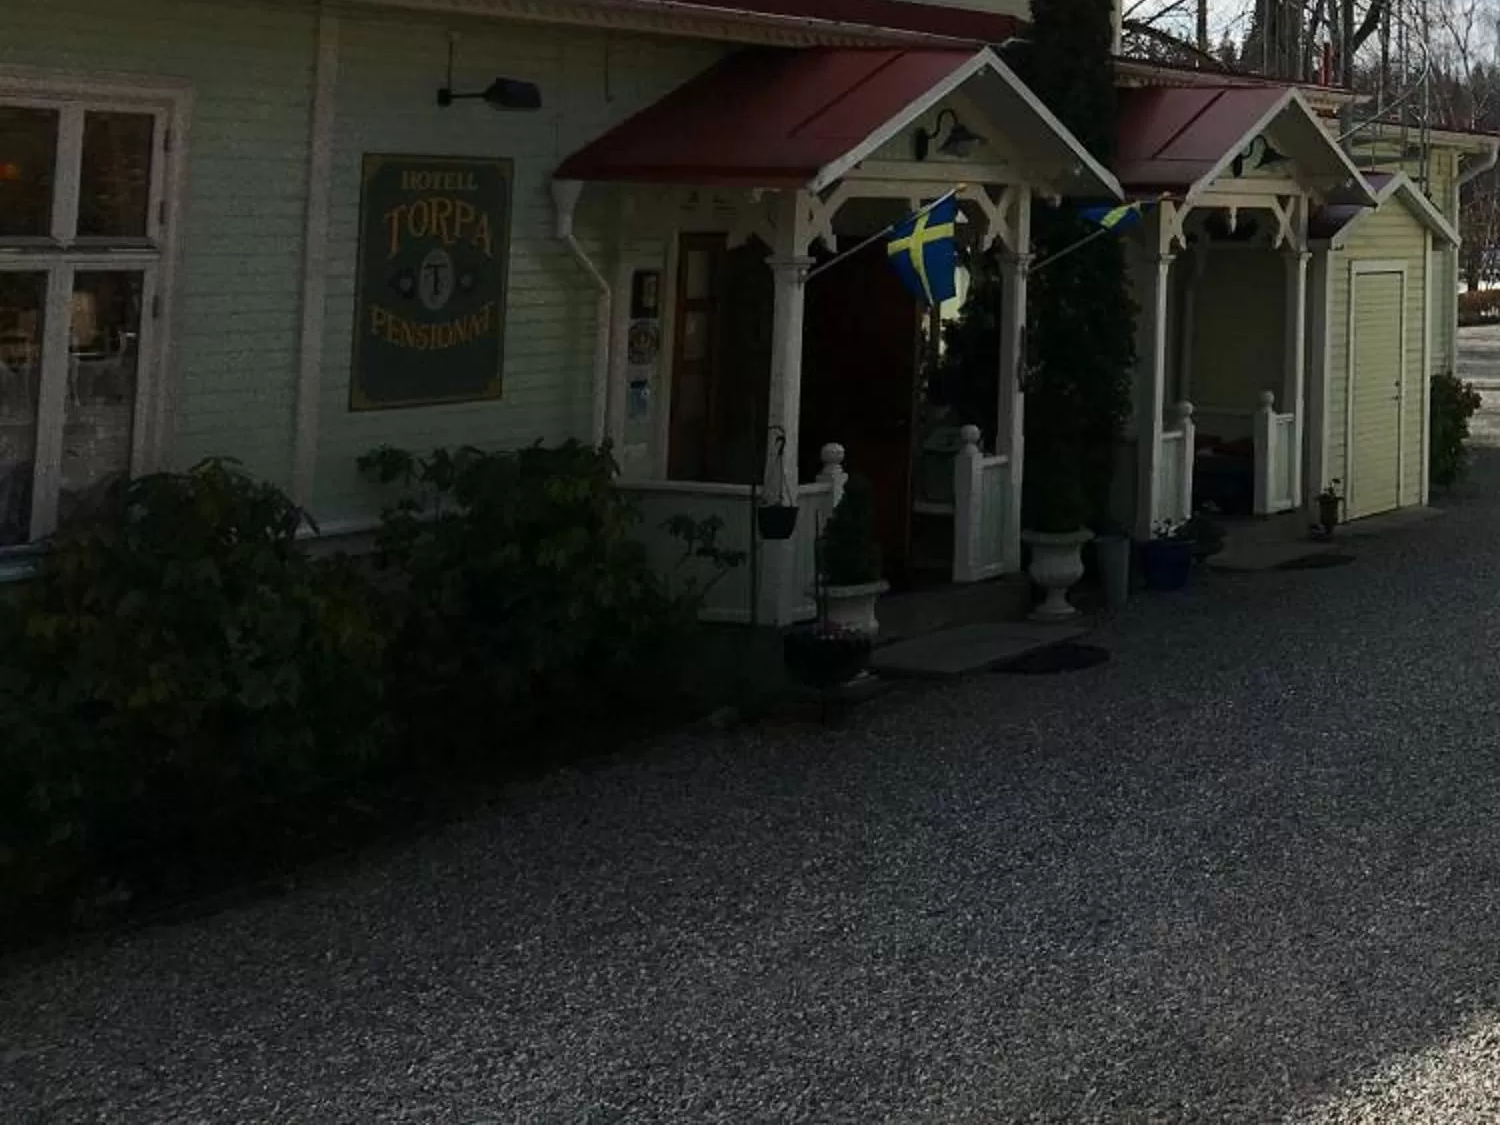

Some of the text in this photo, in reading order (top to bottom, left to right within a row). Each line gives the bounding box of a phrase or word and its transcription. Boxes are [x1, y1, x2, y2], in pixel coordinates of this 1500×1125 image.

[401, 170, 478, 191] HOTELL
[384, 197, 494, 259] TORPA
[369, 302, 495, 349] PENSIONAT
